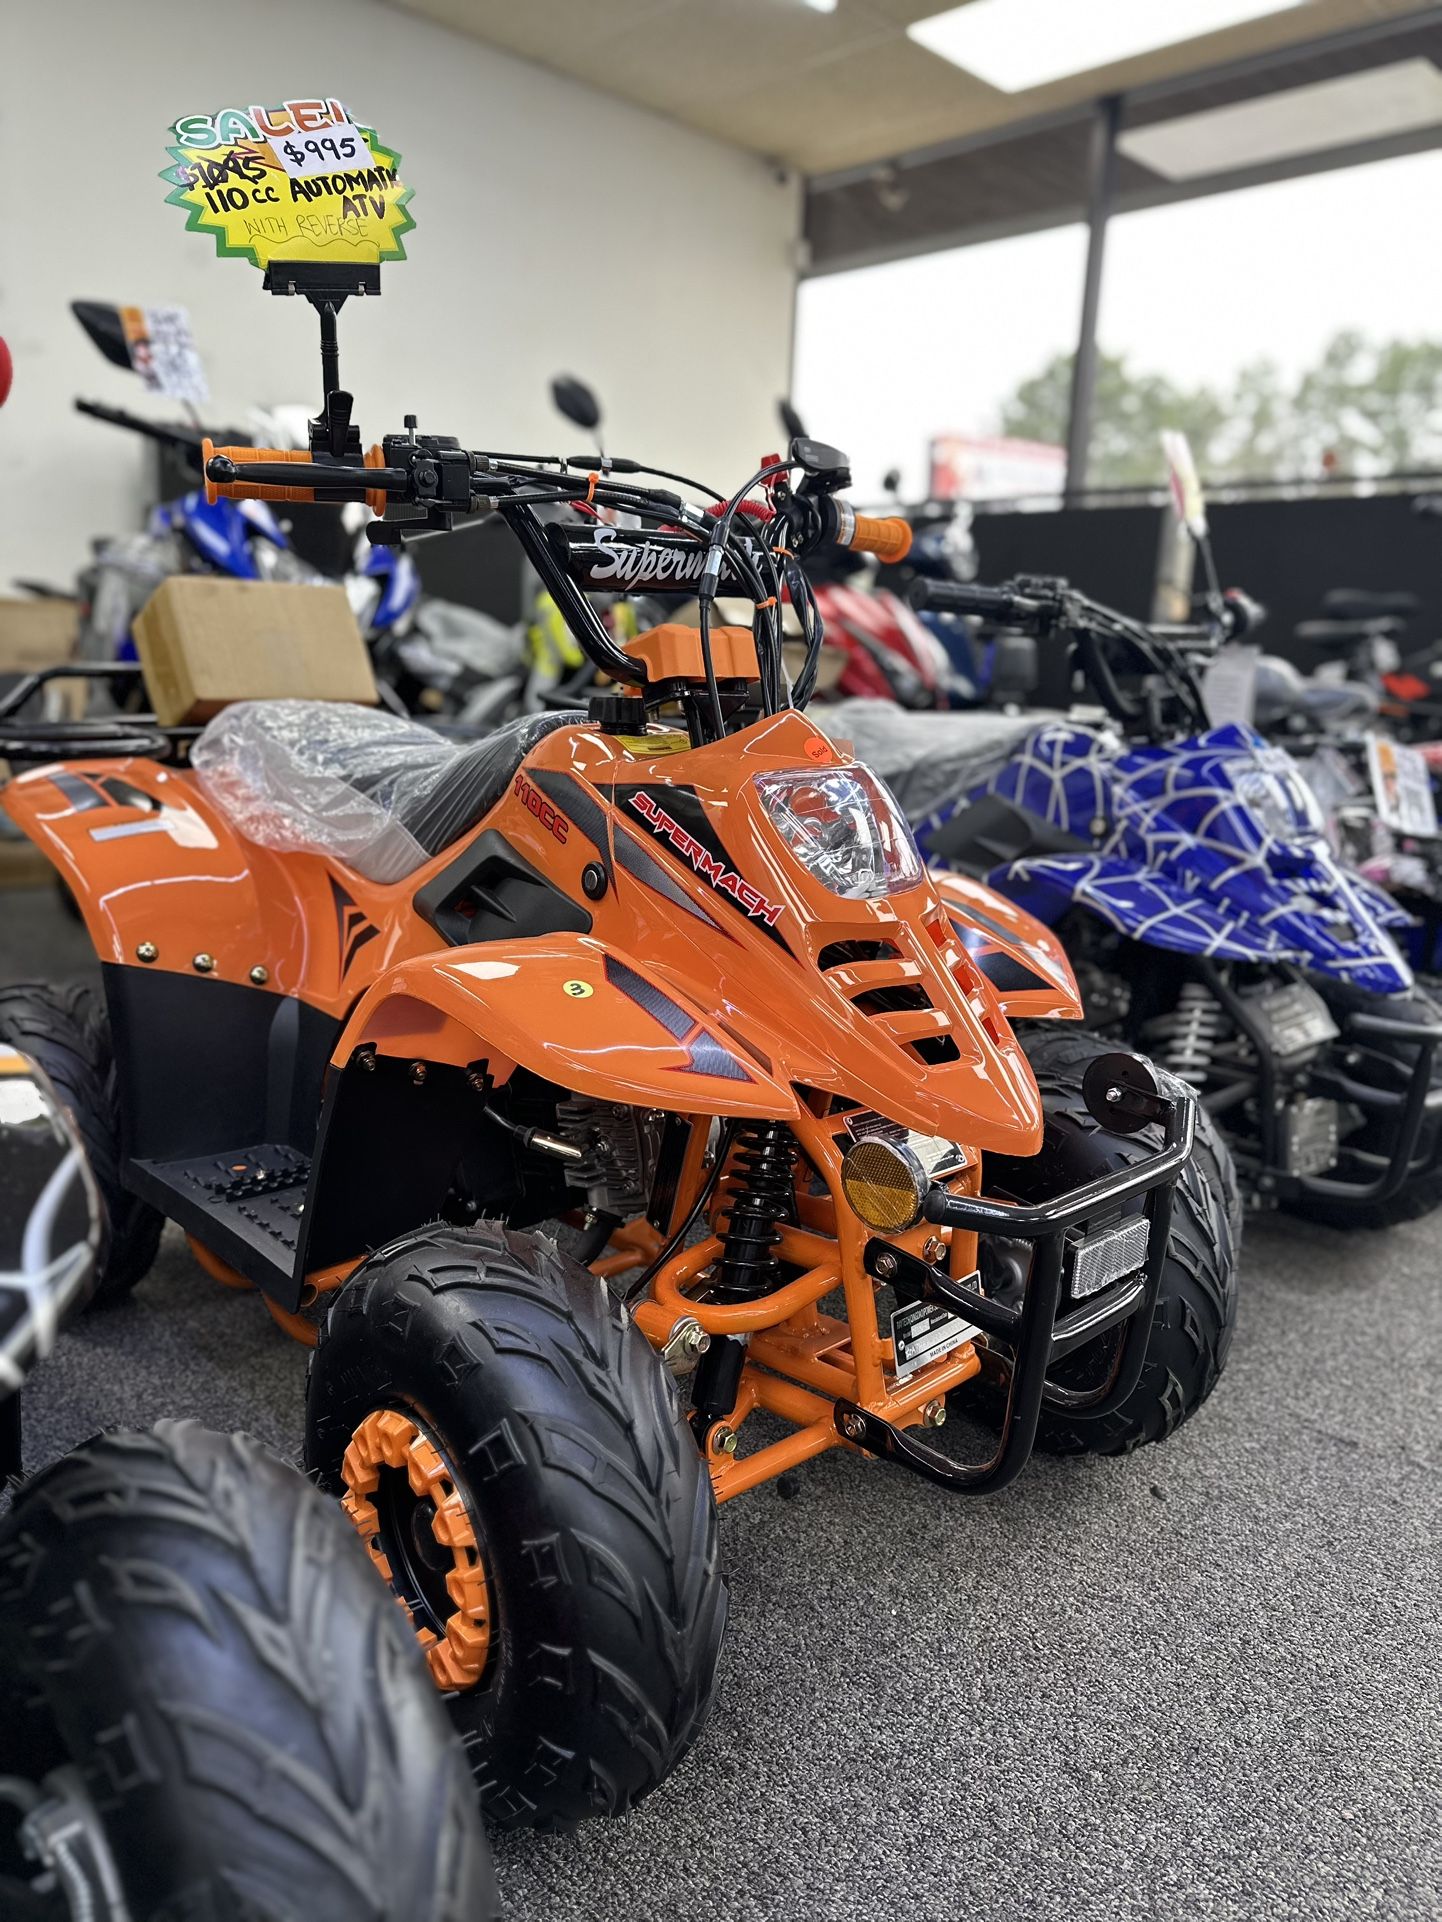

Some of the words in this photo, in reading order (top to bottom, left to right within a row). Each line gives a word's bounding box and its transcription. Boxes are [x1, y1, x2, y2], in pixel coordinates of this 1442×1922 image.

[283, 137, 356, 167] $995
[342, 194, 386, 220] ATV
[244, 216, 288, 237] WITH
[297, 214, 368, 238] REVERSE
[590, 528, 764, 591] Supermh
[811, 745, 828, 758] Sold
[513, 774, 569, 844] 110CC
[629, 791, 786, 926] SUPERMACH
[930, 1348, 941, 1357] MADE
[946, 1339, 958, 1348] CHINA
